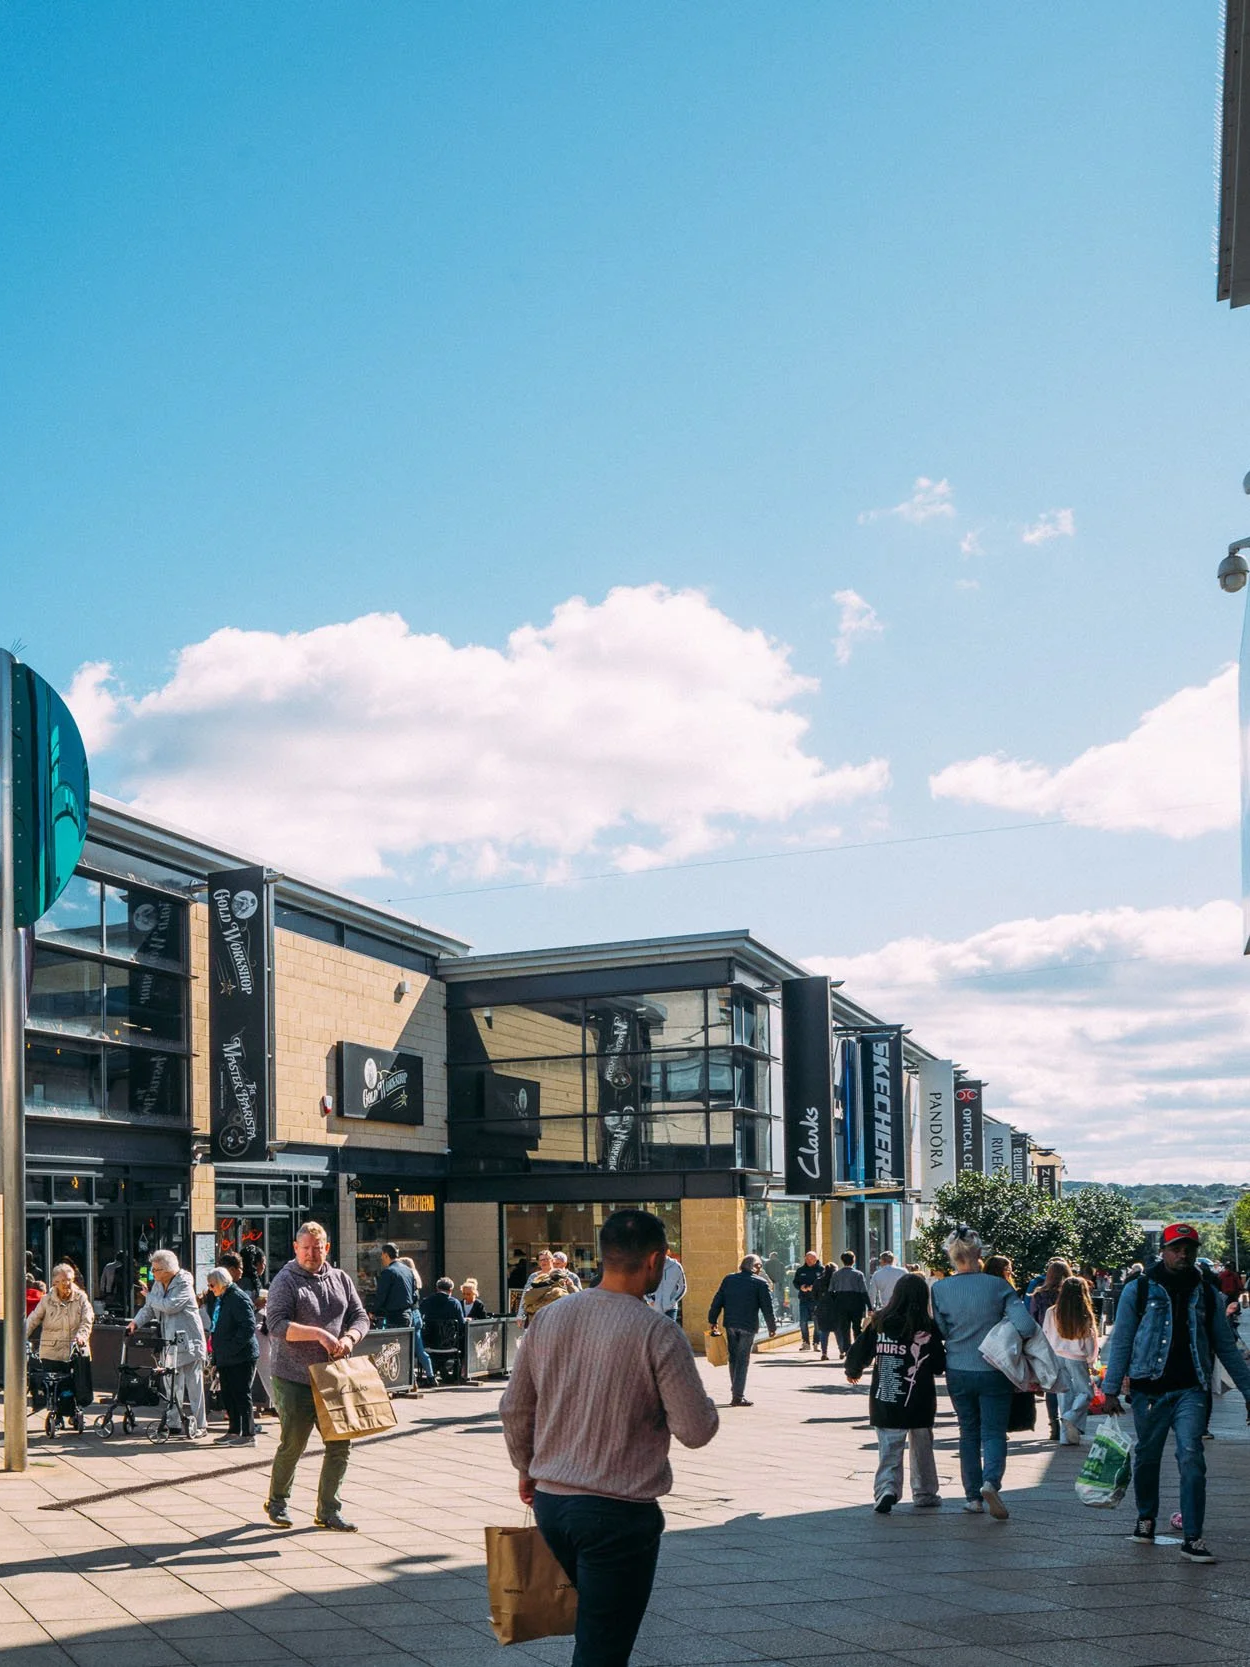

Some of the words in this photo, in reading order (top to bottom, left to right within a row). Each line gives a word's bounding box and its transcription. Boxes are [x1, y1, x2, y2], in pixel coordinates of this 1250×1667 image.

[213, 888, 231, 923] GOLD
[222, 922, 252, 995] WORKSHOP
[222, 1037, 243, 1090] MASTER
[236, 1089, 257, 1141] BARISTA
[246, 1081, 257, 1096] THE
[797, 1107, 820, 1178] Clarks
[929, 1092, 944, 1169] PANDORA
[962, 1108, 973, 1152] OPTICAL
[991, 1137, 1004, 1170] RIVER
